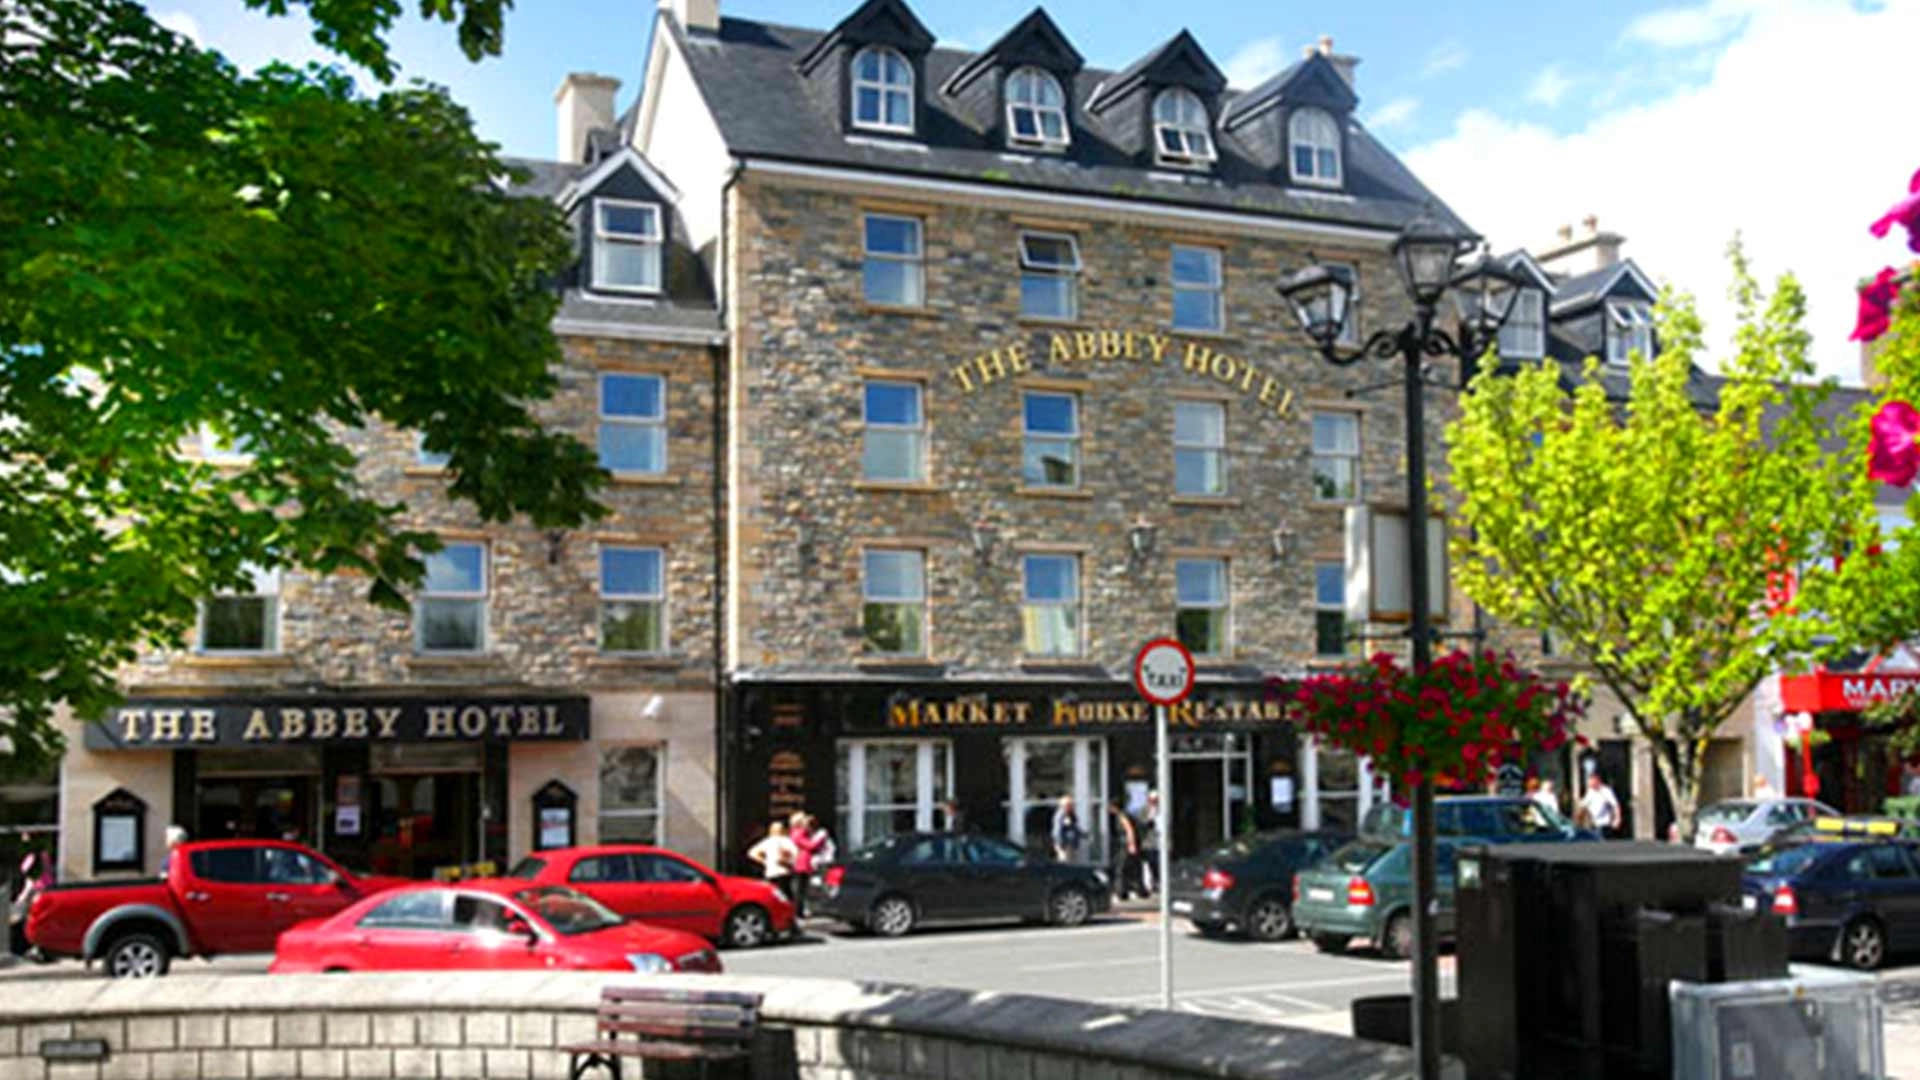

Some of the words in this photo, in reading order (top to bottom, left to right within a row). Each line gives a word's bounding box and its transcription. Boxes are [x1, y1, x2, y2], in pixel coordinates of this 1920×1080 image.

[949, 342, 1032, 394] THE
[1049, 329, 1172, 364] ABBEY
[1183, 342, 1297, 418] HOTEL
[1146, 672, 1184, 688] TAXI
[119, 708, 217, 742] THE
[242, 707, 403, 740] ABBEY
[424, 705, 565, 737] HOTEL
[889, 698, 1032, 727] MARKET
[1052, 698, 1149, 726] HOUSE
